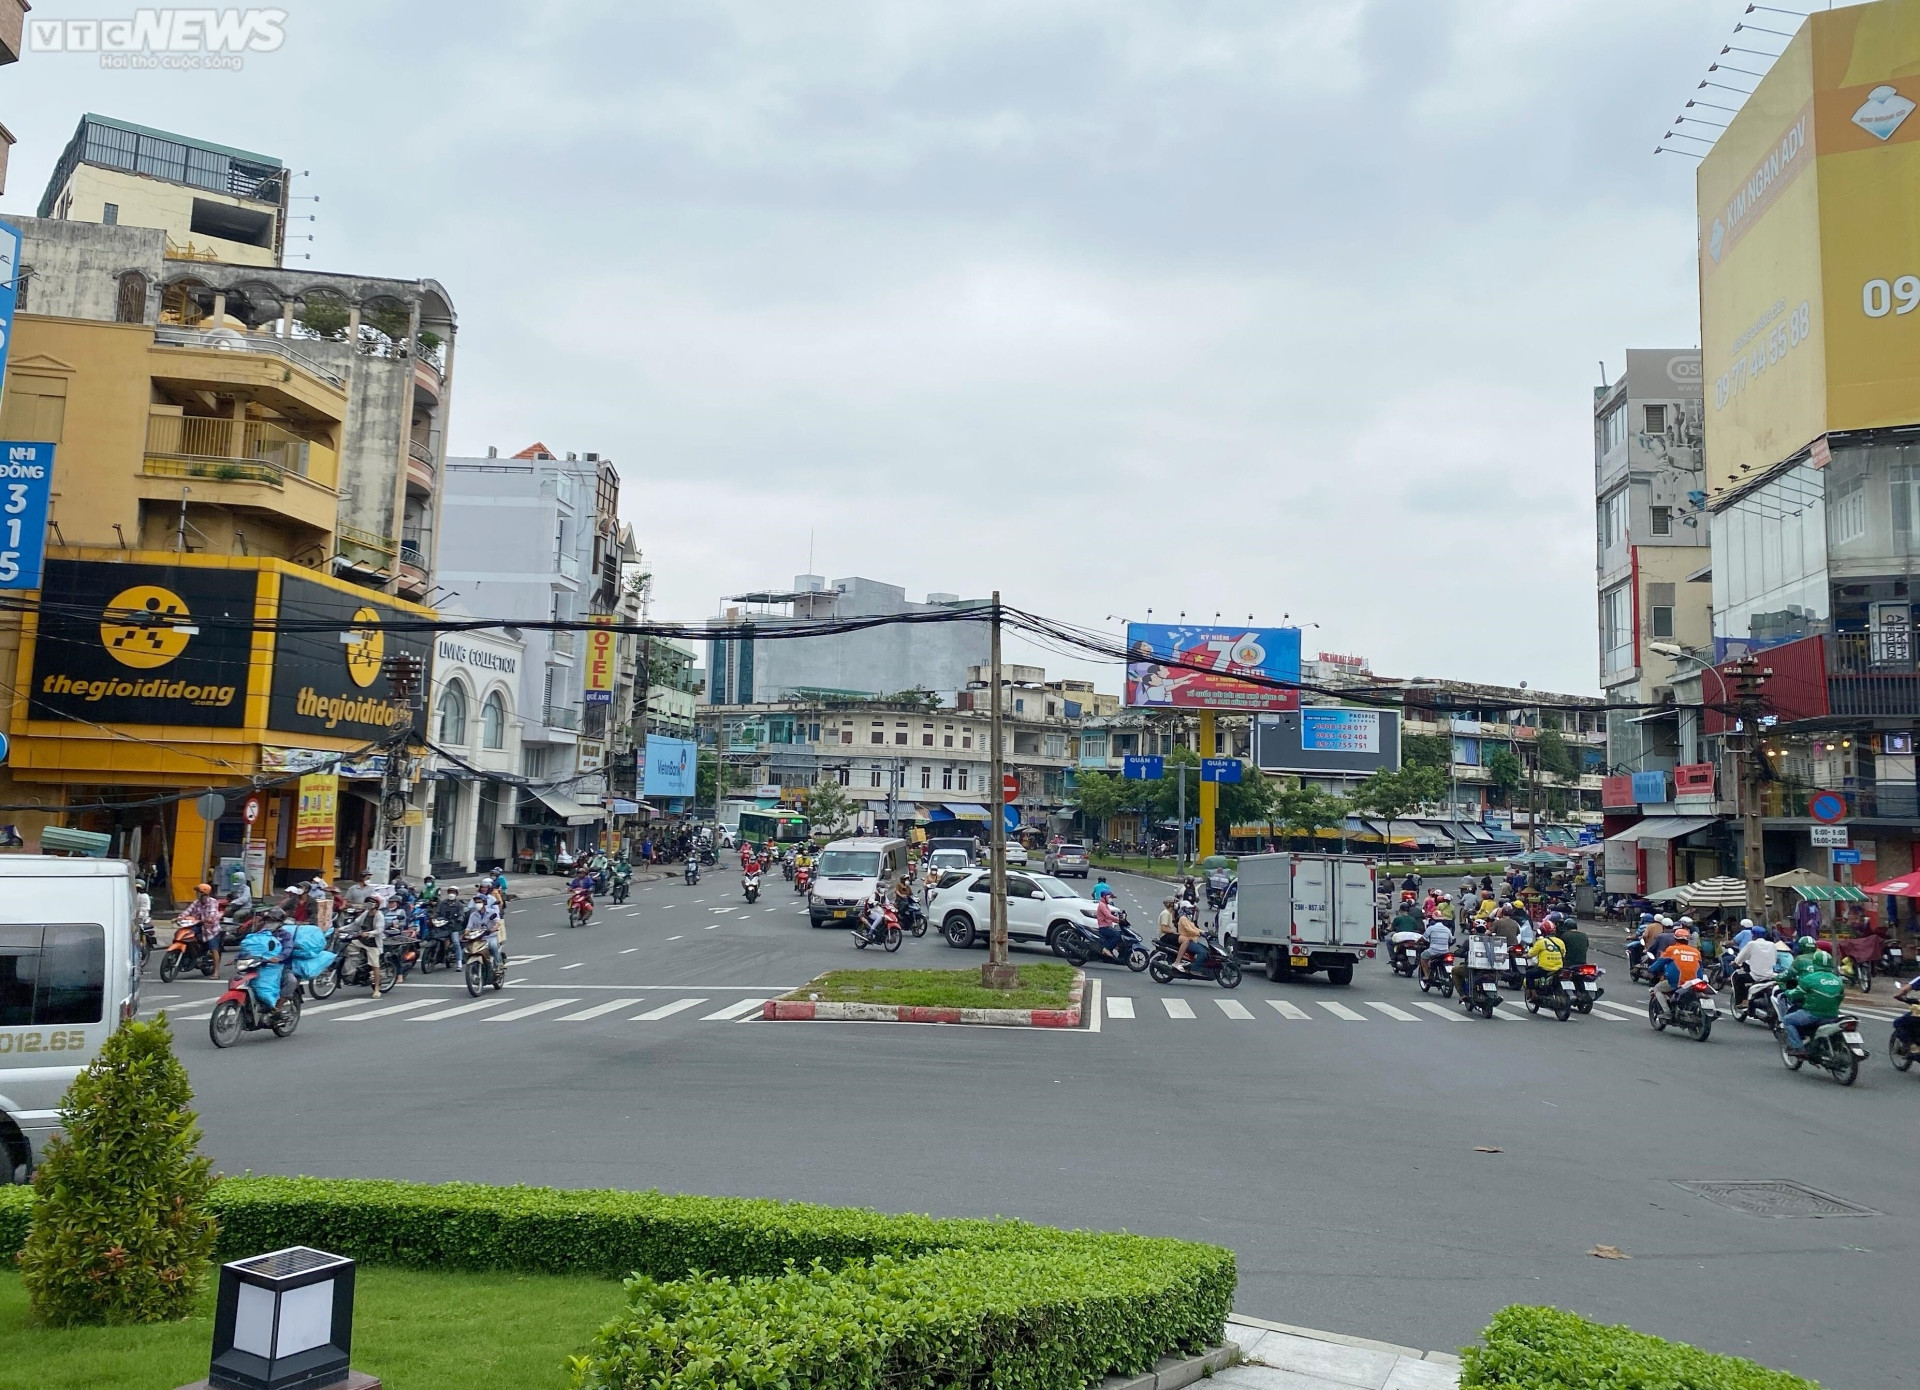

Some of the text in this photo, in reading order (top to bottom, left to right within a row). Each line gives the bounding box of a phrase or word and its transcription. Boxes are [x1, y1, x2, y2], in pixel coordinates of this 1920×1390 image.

[1727, 114, 1807, 231] KIM NGAN ADV
[1863, 275, 1920, 318] 09
[1732, 354, 1748, 398] 77
[1750, 338, 1767, 381] 44
[1768, 319, 1788, 366] 55
[1790, 300, 1810, 349] 88
[9, 447, 36, 461] NHI
[0, 461, 45, 479] ĐỒNG
[469, 648, 516, 674] COLLECTION
[1207, 632, 1267, 673] 76
[42, 674, 236, 707] thegioididong
[1206, 759, 1228, 767] QUẬN
[1820, 978, 1839, 987] Grab
